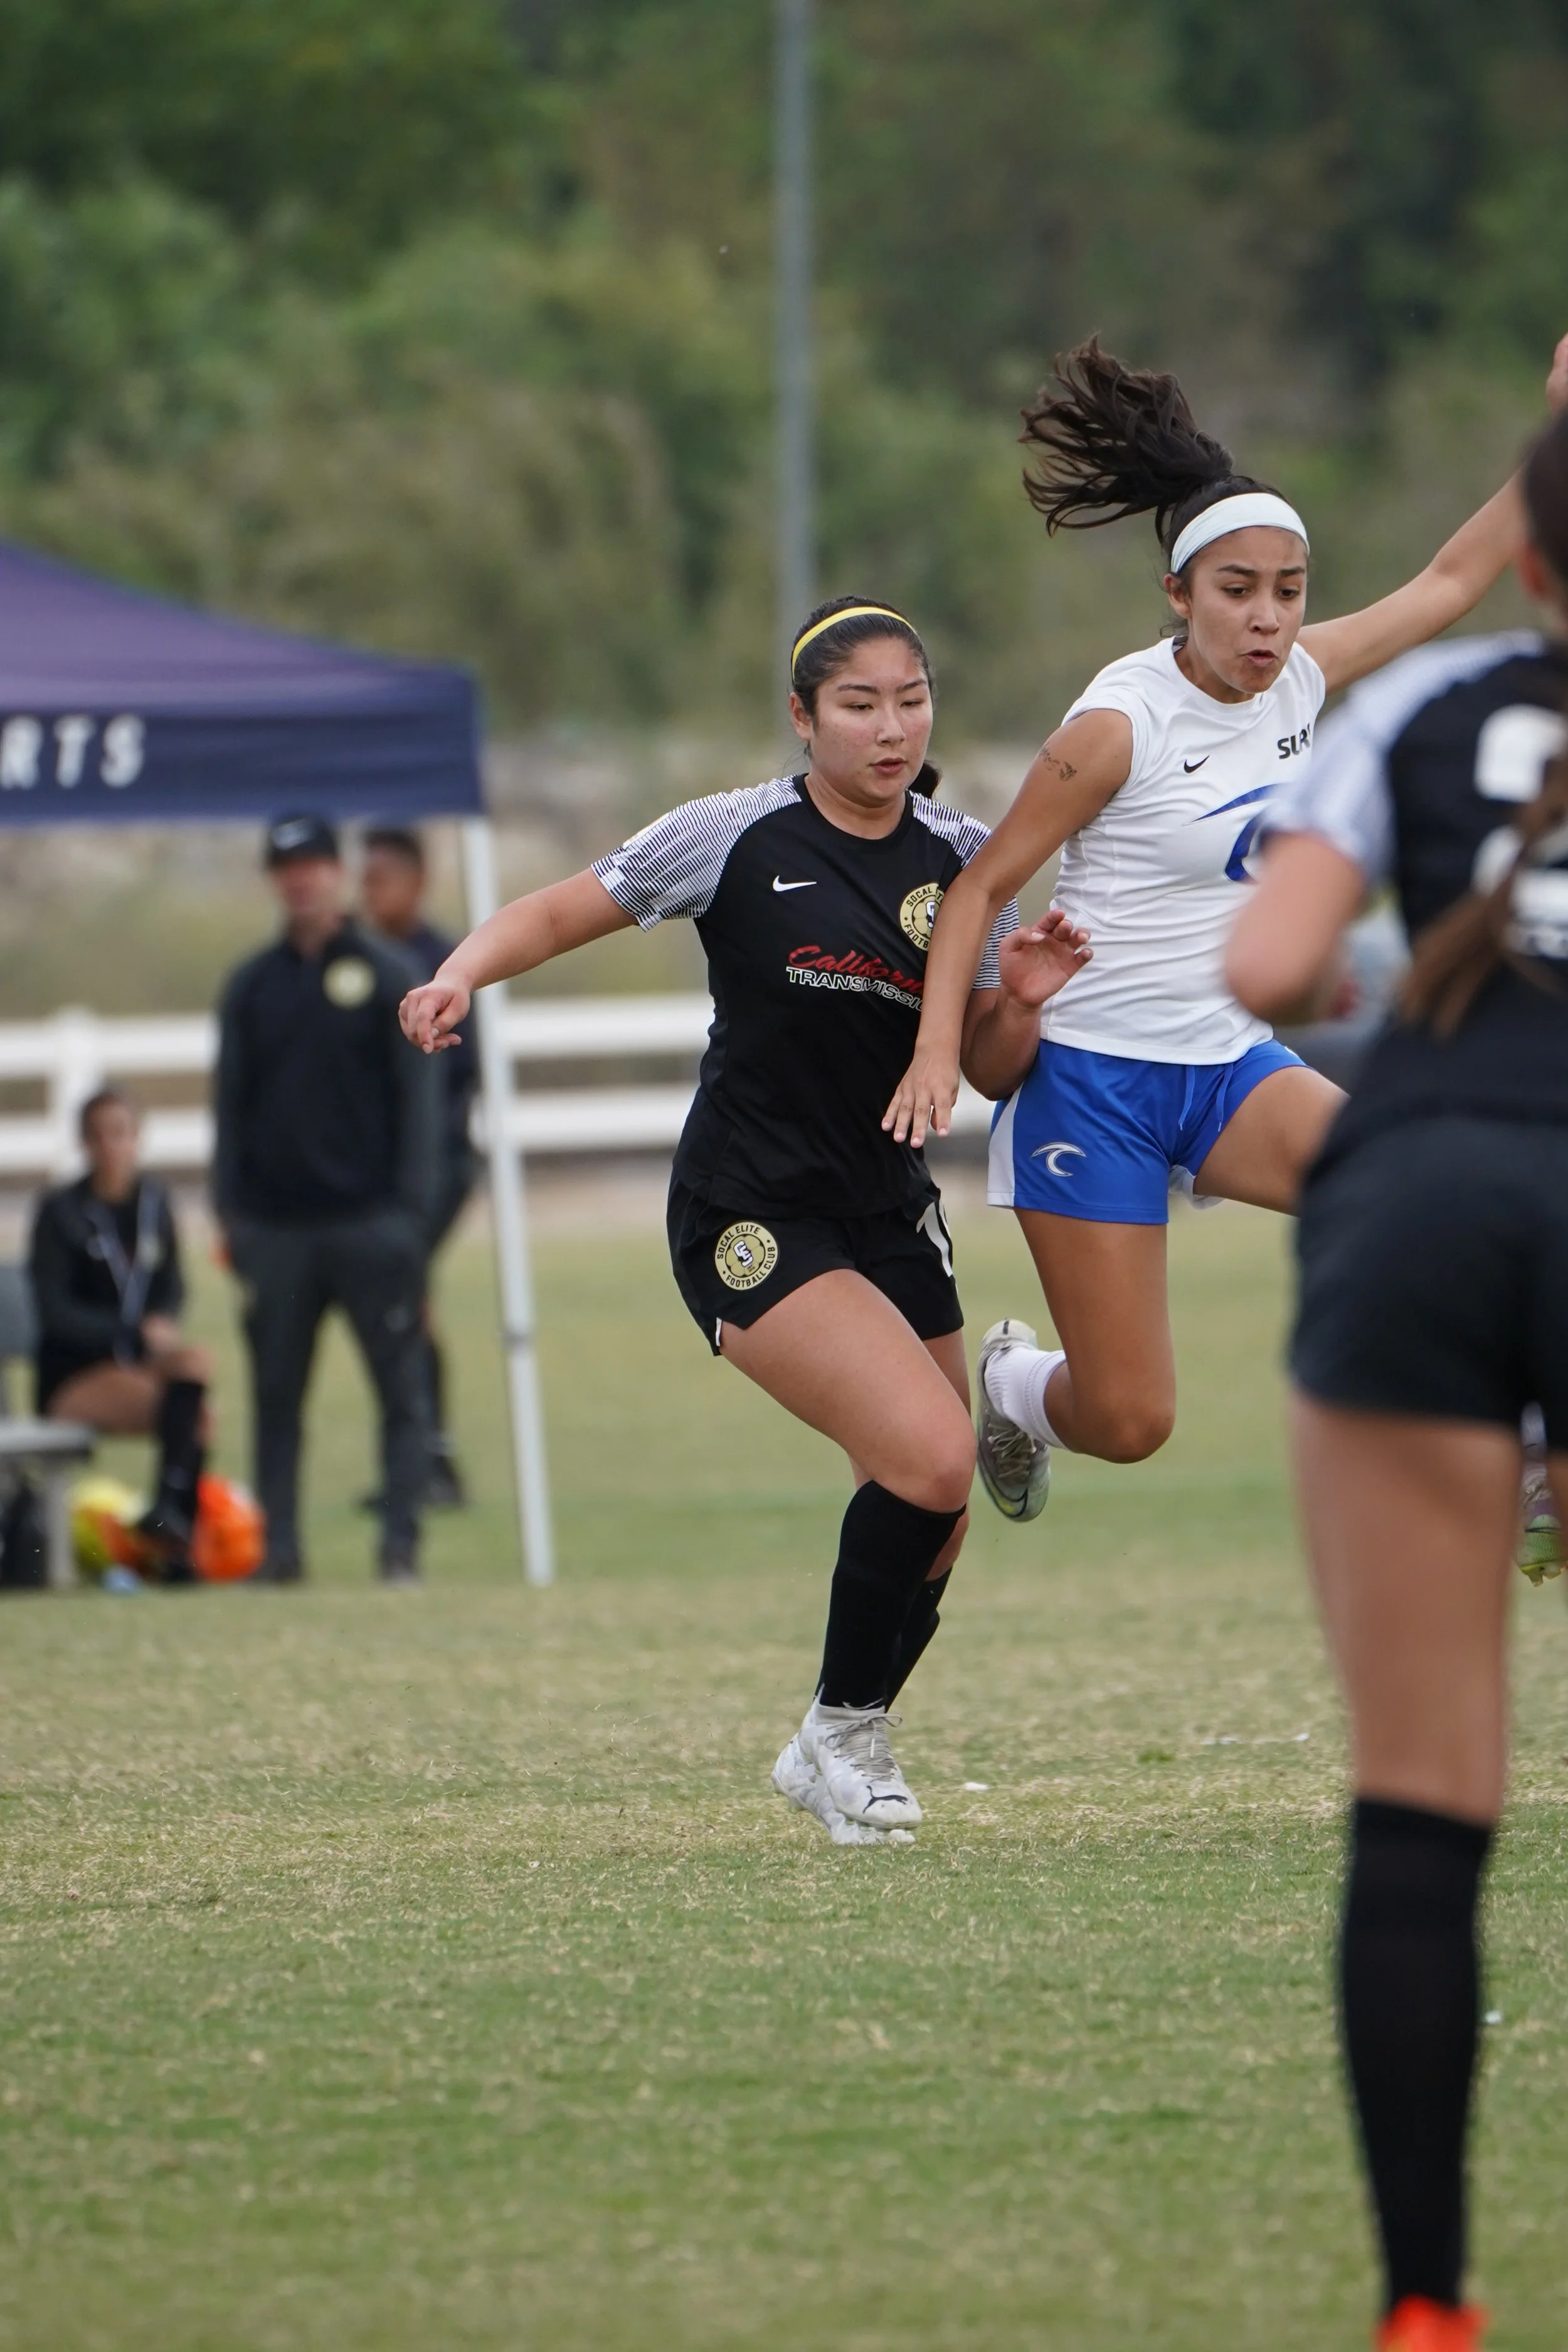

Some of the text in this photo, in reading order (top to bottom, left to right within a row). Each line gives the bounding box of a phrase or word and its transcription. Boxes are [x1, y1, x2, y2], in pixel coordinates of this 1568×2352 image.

[906, 886, 933, 907] SOCAL
[904, 924, 930, 948] FOOTB
[788, 945, 923, 995] Californ
[717, 1224, 761, 1259] SOCAL ELITE
[726, 1271, 766, 1288] FOOTBALL
[763, 1246, 776, 1270] CLUB
